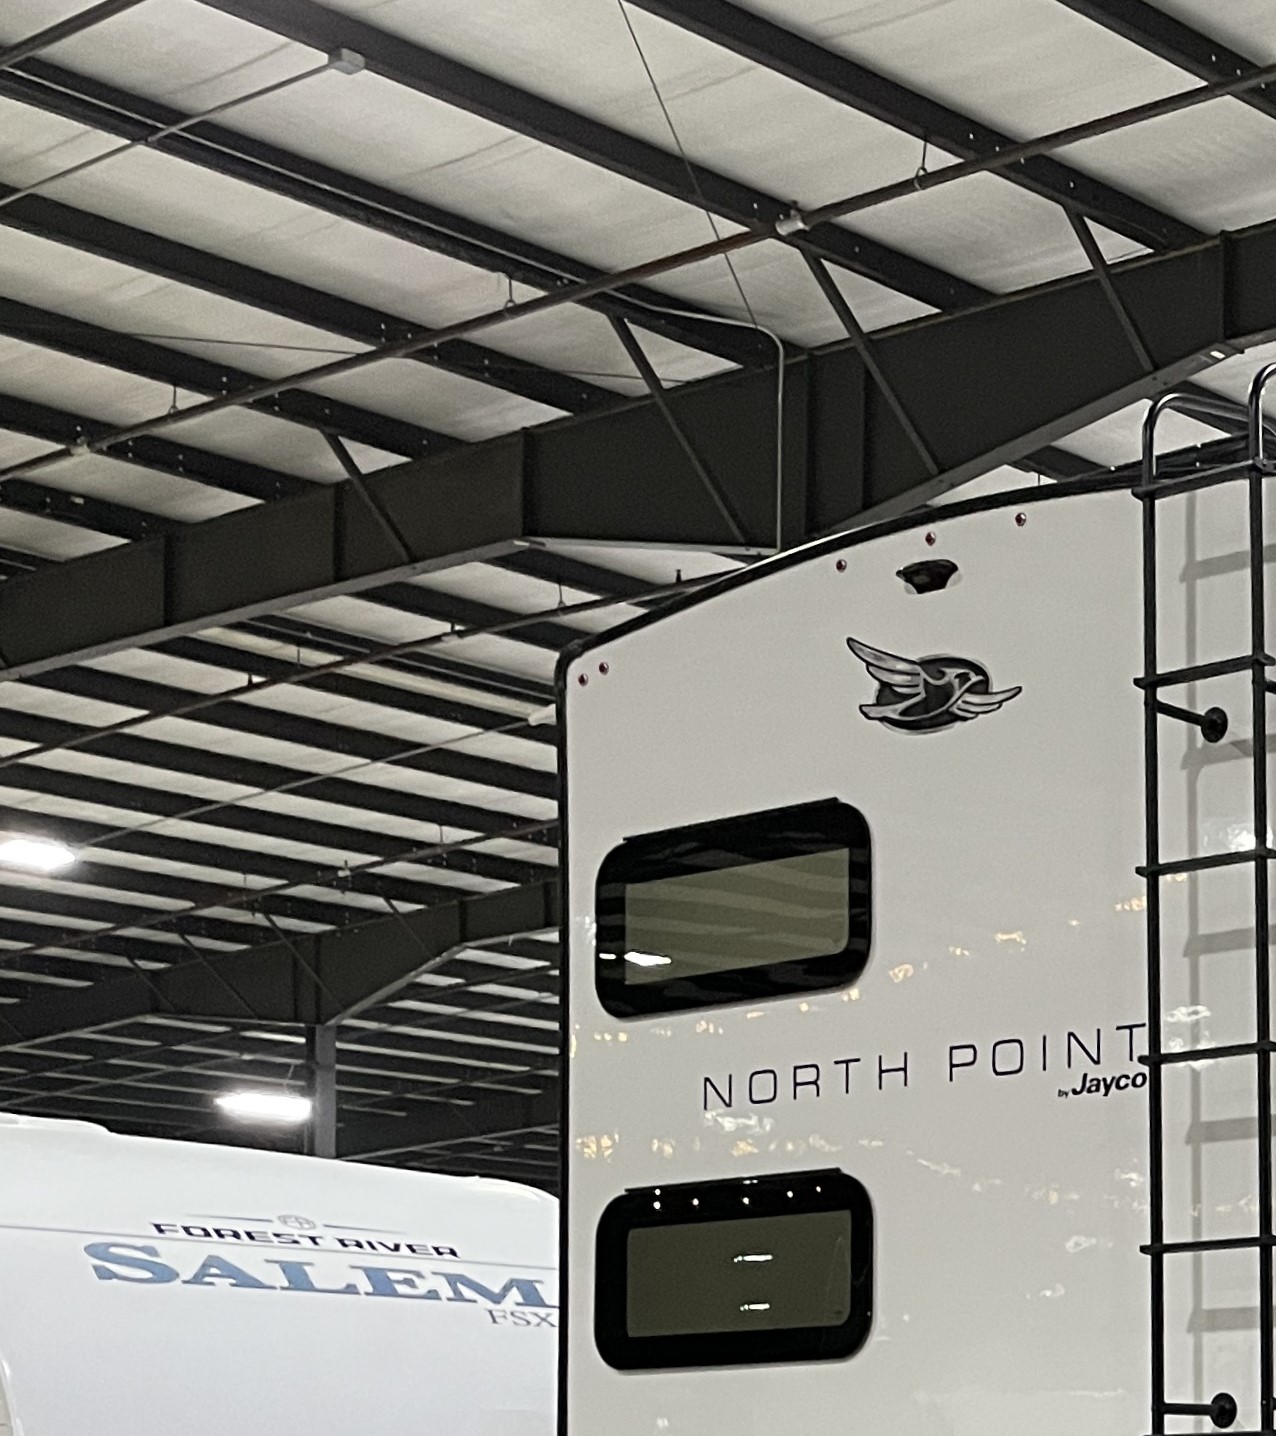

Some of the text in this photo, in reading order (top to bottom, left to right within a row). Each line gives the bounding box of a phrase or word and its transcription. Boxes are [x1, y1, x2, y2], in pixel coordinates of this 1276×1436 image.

[703, 1022, 1147, 1111] NORTH POINT
[1071, 1072, 1148, 1097] Jayco
[149, 1221, 324, 1246] FOREST
[333, 1237, 461, 1259] RIVER
[83, 1241, 559, 1307] SALEM
[485, 1308, 557, 1327] FSX
